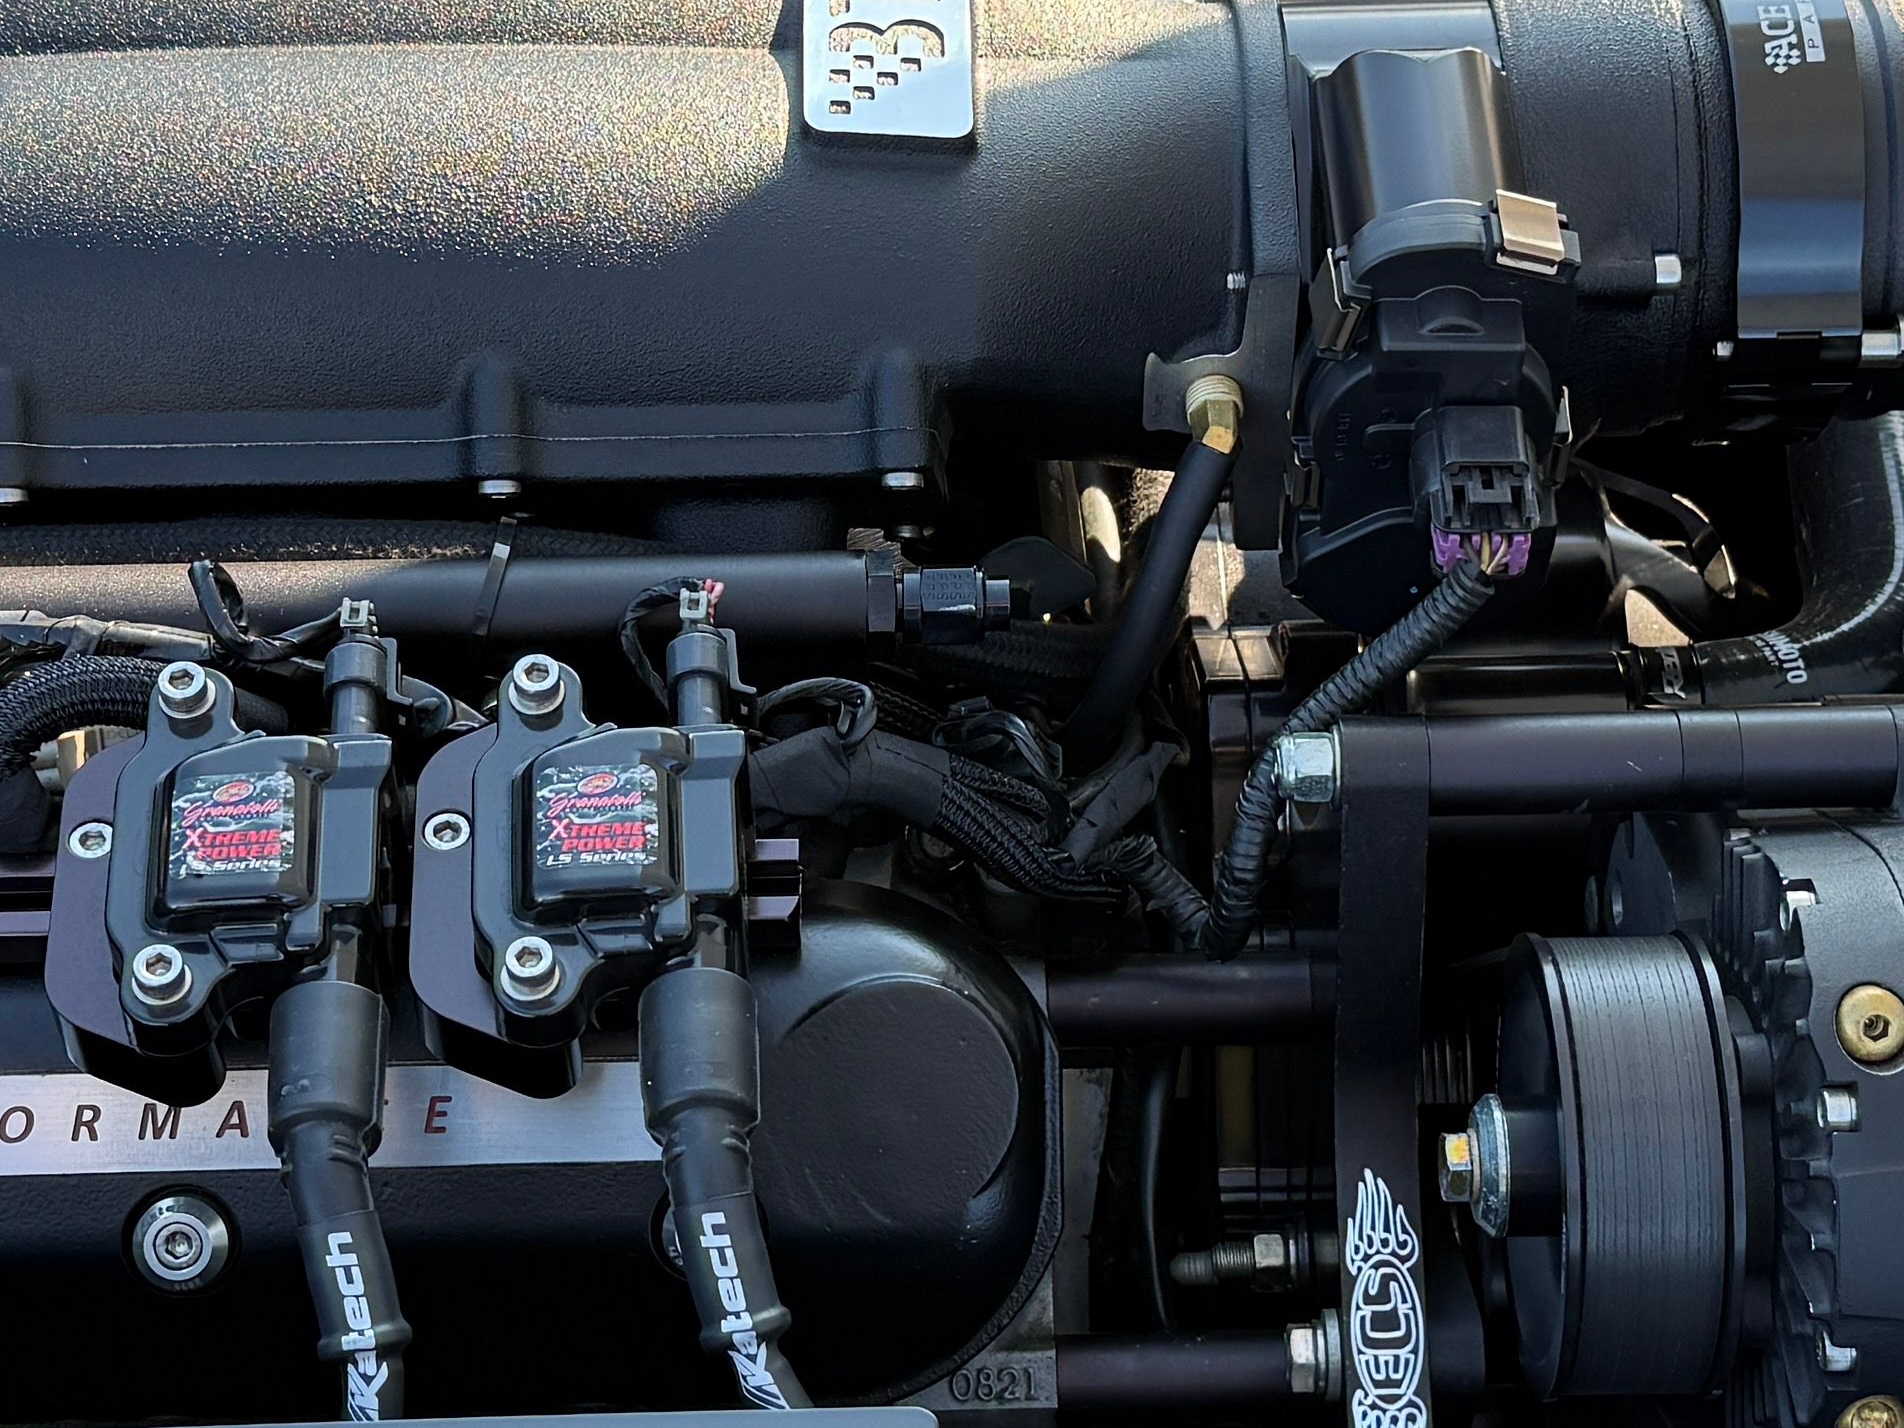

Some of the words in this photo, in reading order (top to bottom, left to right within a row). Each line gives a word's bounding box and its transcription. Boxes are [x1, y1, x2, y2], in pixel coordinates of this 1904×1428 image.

[182, 823, 282, 852] XTREME
[547, 818, 647, 848] XTREME
[196, 843, 282, 861] POWER
[562, 837, 646, 853] POWER
[212, 855, 283, 871] Series
[546, 852, 572, 866] LS
[578, 849, 646, 864] Series
[1362, 1263, 1420, 1398] ECS
[952, 1366, 1043, 1403] 0821
